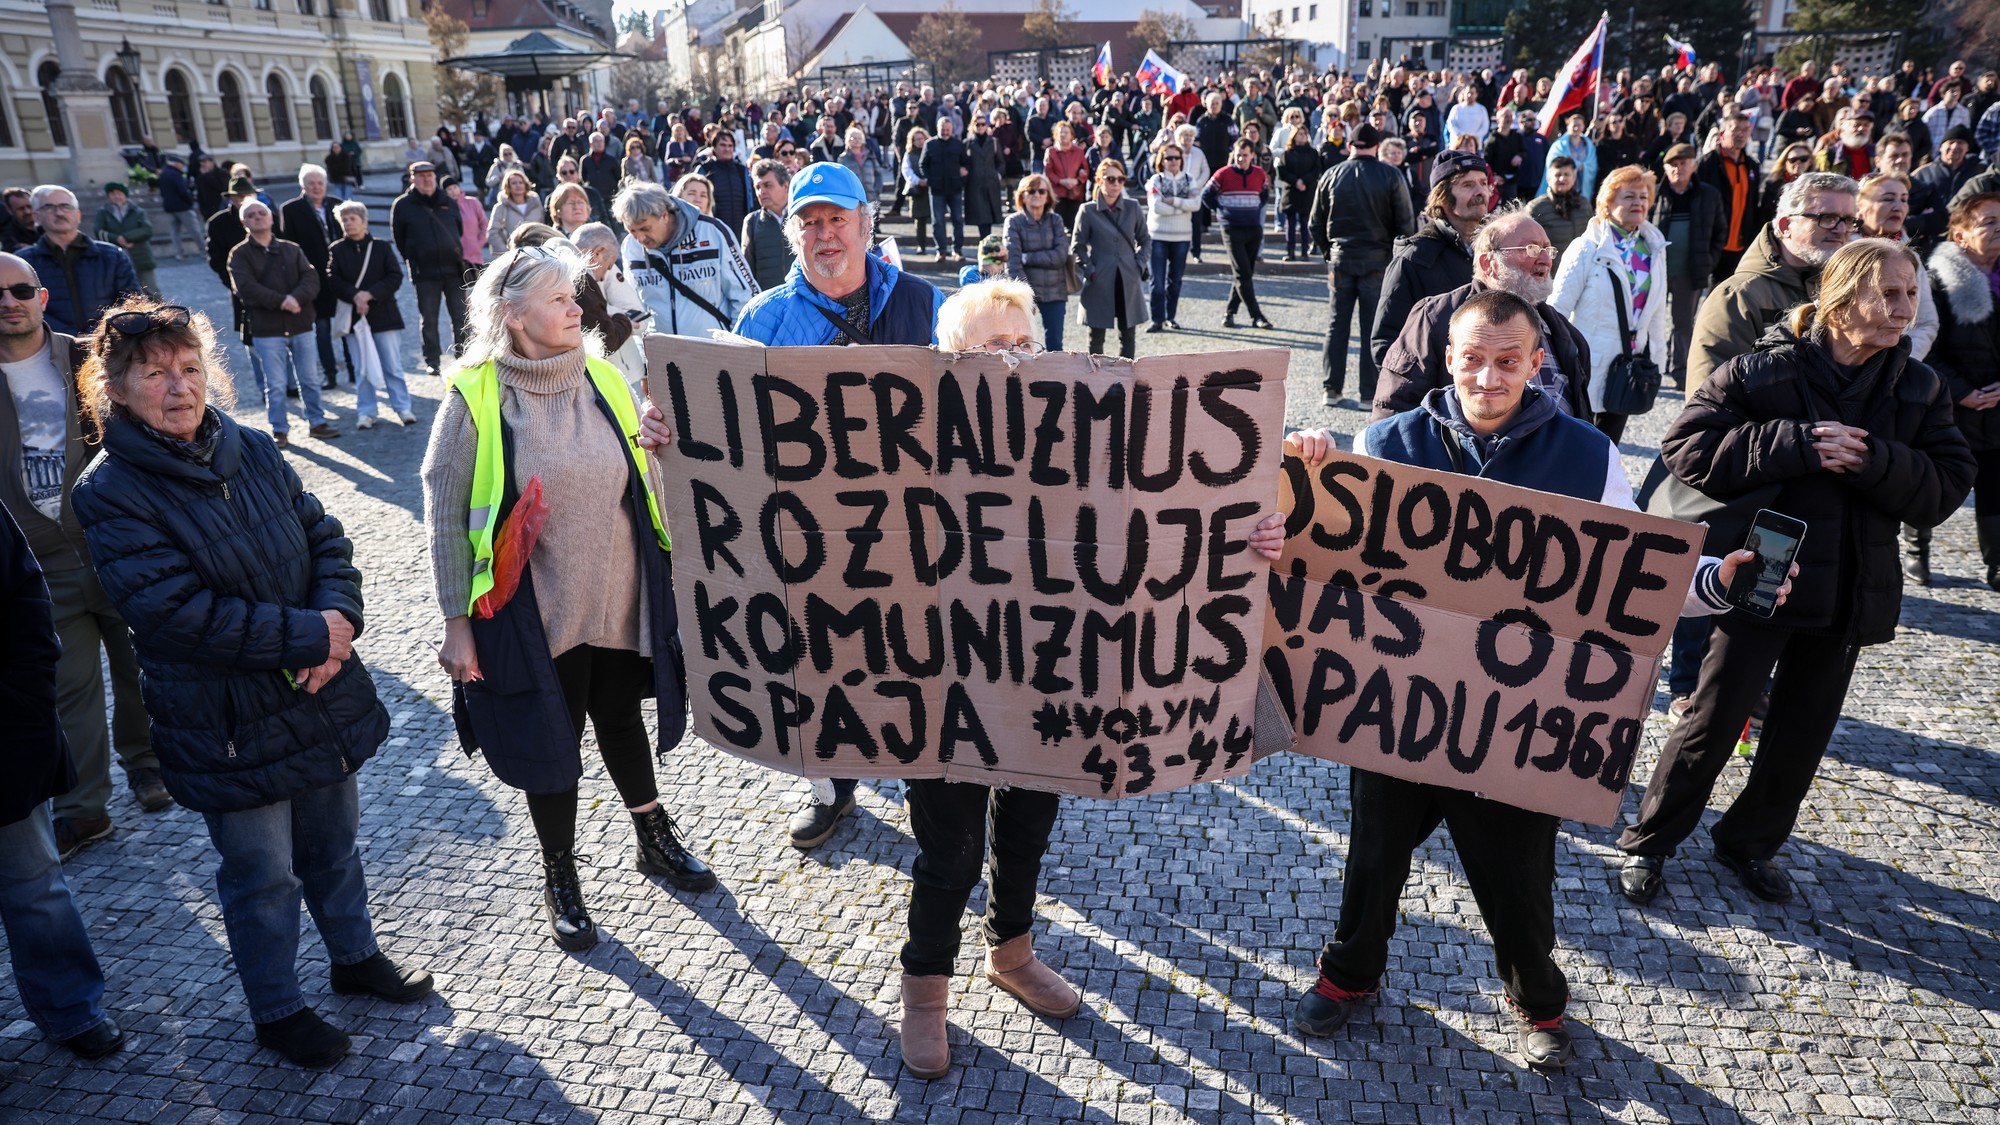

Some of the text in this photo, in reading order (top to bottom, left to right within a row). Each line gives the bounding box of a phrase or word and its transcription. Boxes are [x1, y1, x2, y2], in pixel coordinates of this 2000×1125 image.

[679, 266, 716, 281] DAVID
[667, 362, 1263, 492] LIBERALIZMUS
[689, 479, 1262, 606] ROZDELUJE
[694, 579, 1252, 698] KOMUNIZMUS
[1474, 603, 1634, 703] OD
[708, 669, 1000, 770] SPÁJA
[1032, 685, 1220, 747] #VOLYN
[1081, 714, 1253, 794] 43-44
[1504, 698, 1646, 794] 1968
